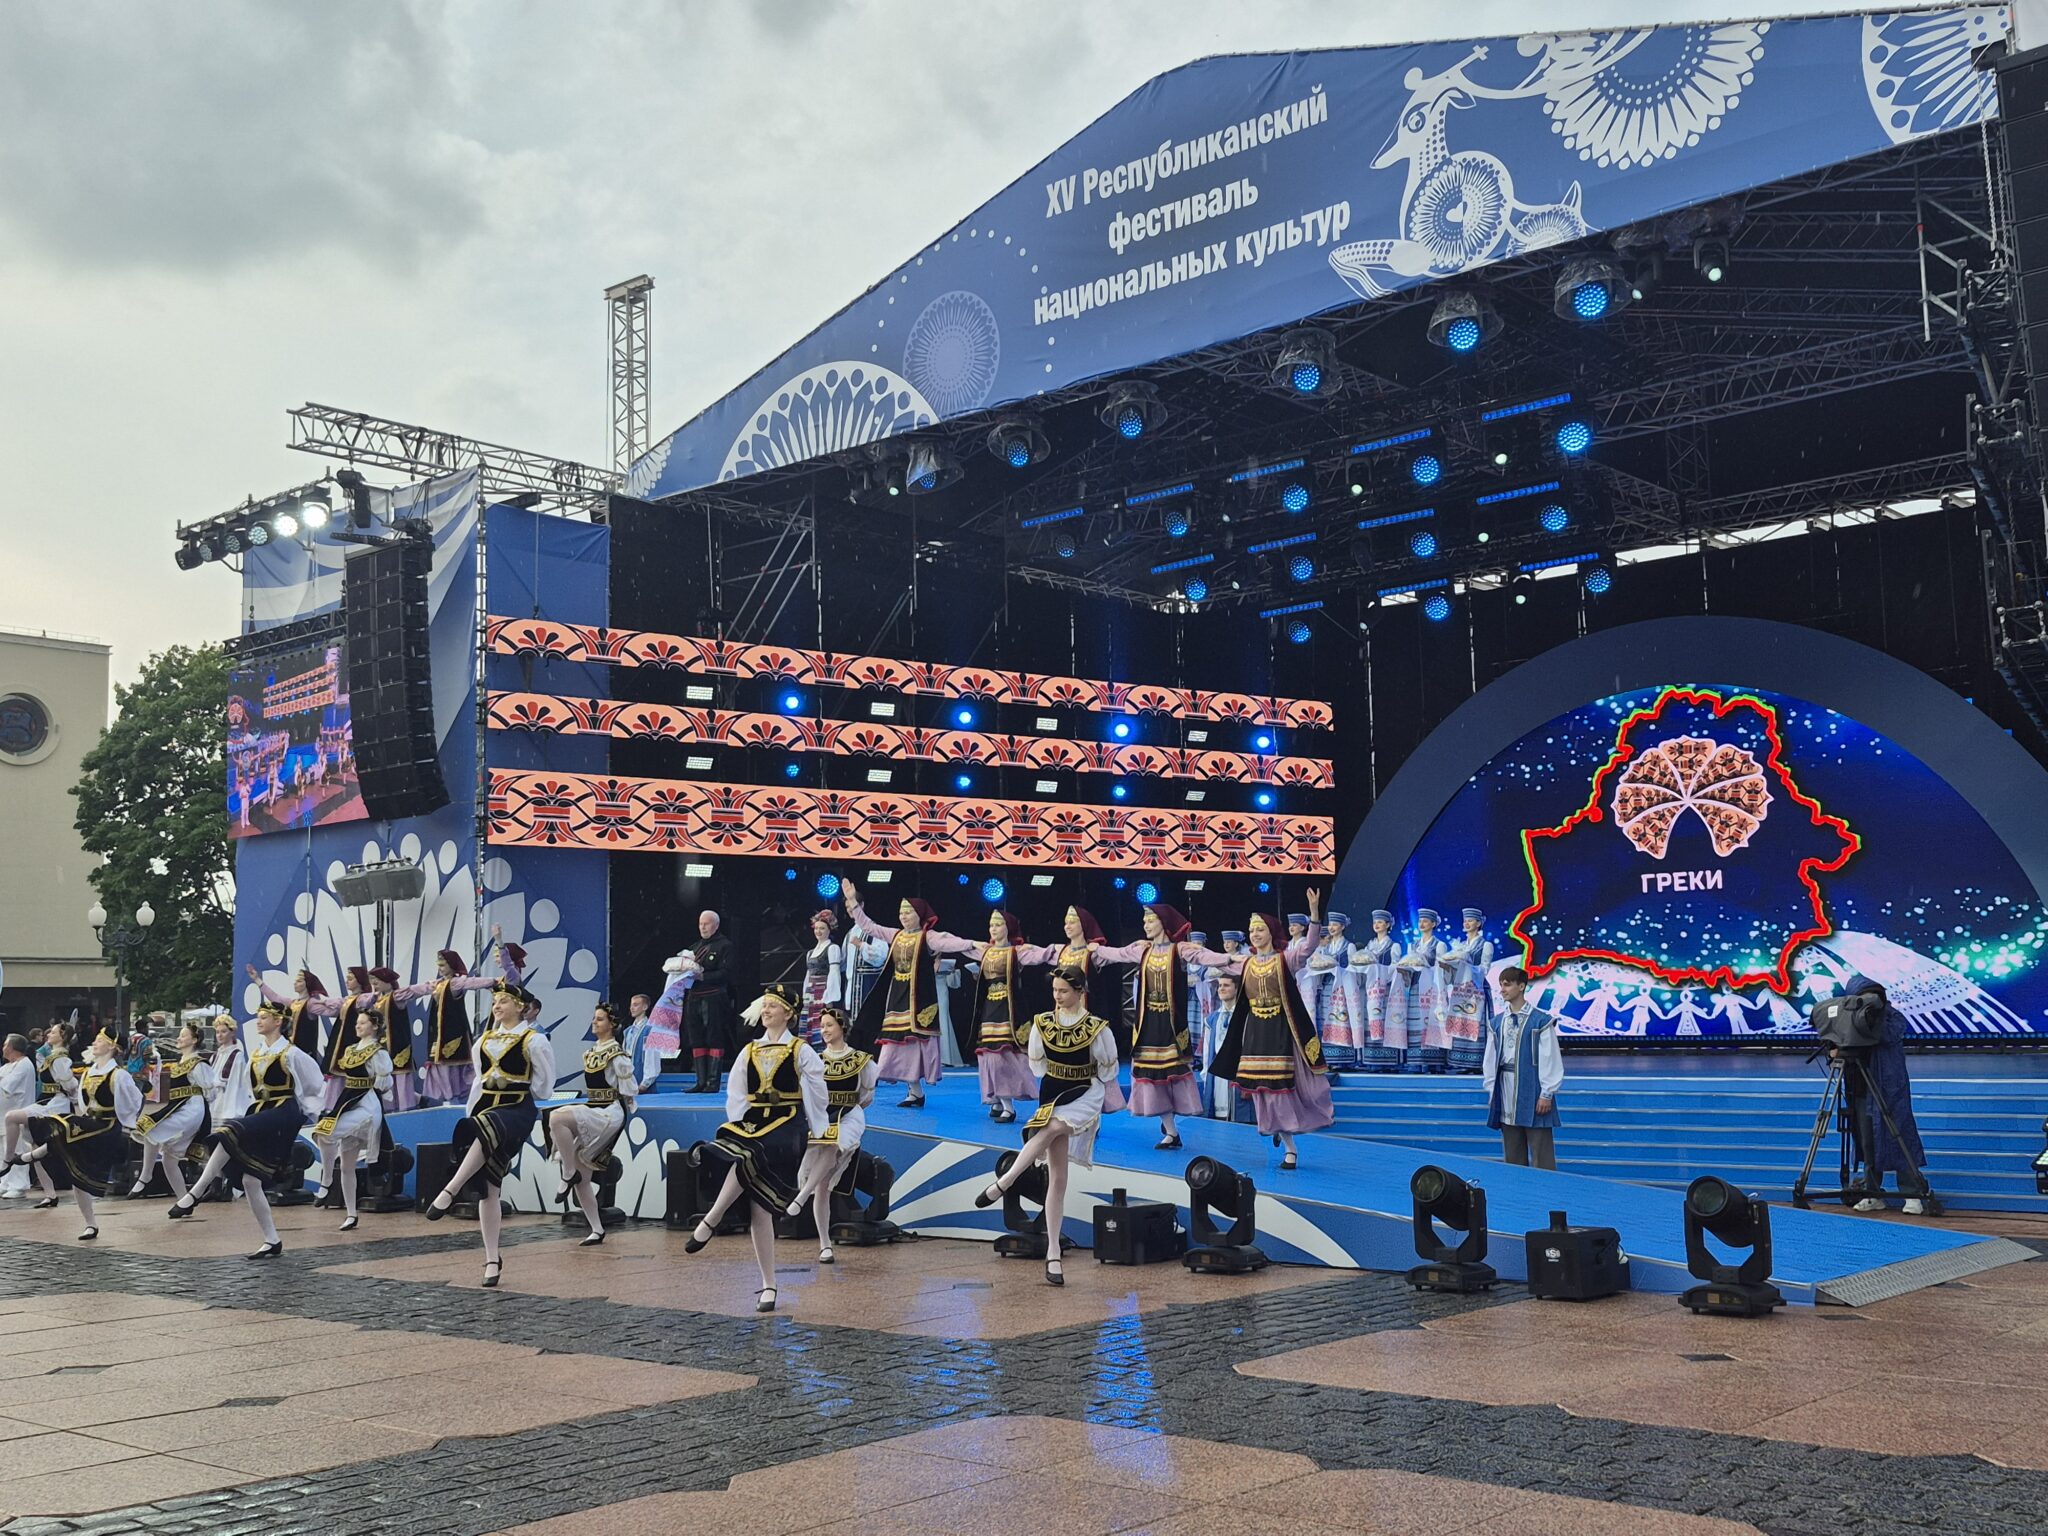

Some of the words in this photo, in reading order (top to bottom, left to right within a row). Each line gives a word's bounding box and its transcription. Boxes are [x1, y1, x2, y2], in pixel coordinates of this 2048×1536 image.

[1082, 83, 1328, 205] Республиканский
[1033, 240, 1227, 325] национальных
[1236, 200, 1350, 267] культур
[1108, 178, 1259, 255] фестиваль
[1641, 869, 1723, 893] ГРЕКИ
